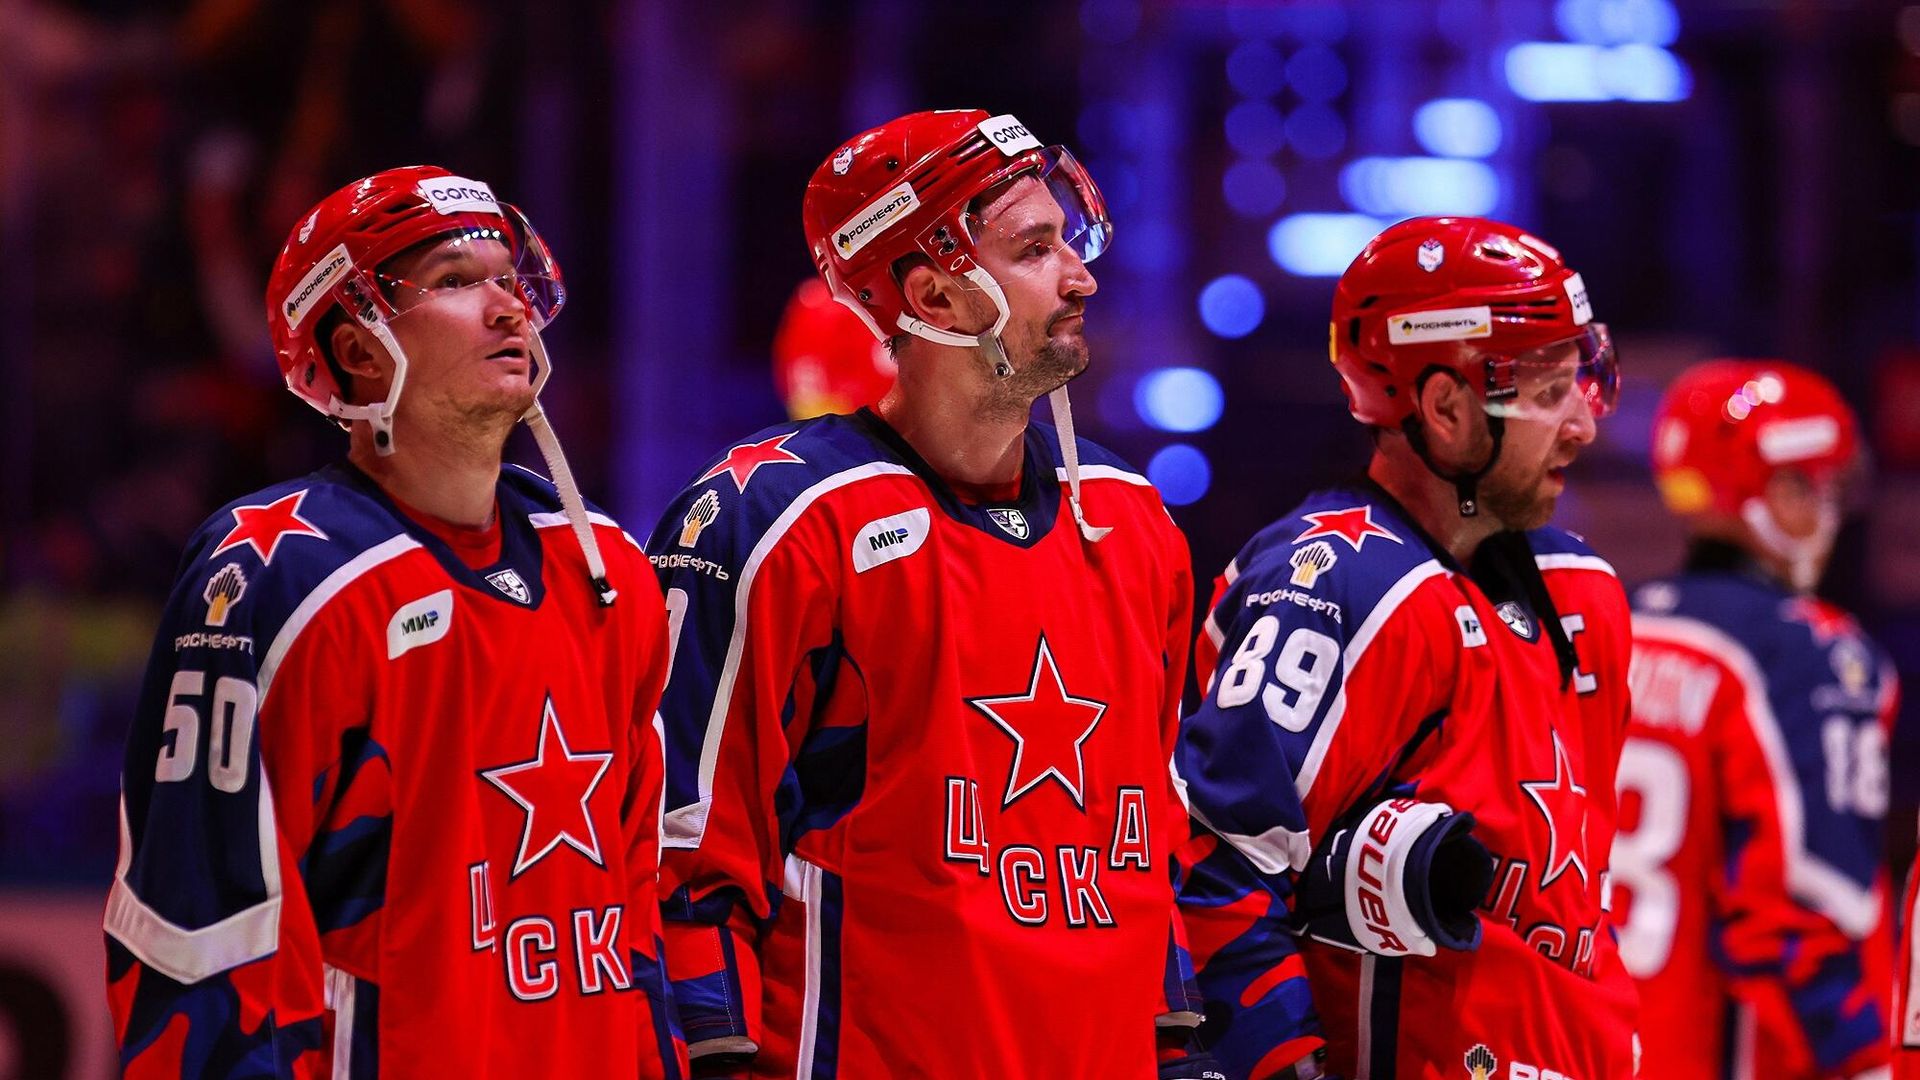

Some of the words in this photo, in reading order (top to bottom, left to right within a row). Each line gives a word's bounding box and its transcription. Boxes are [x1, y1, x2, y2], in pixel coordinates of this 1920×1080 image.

[848, 194, 912, 240] РОСНЕФТЬ
[295, 255, 347, 307] РОСНЕФТЬ
[401, 610, 439, 636] МИР
[1216, 614, 1341, 733] 89
[155, 671, 257, 793] 50
